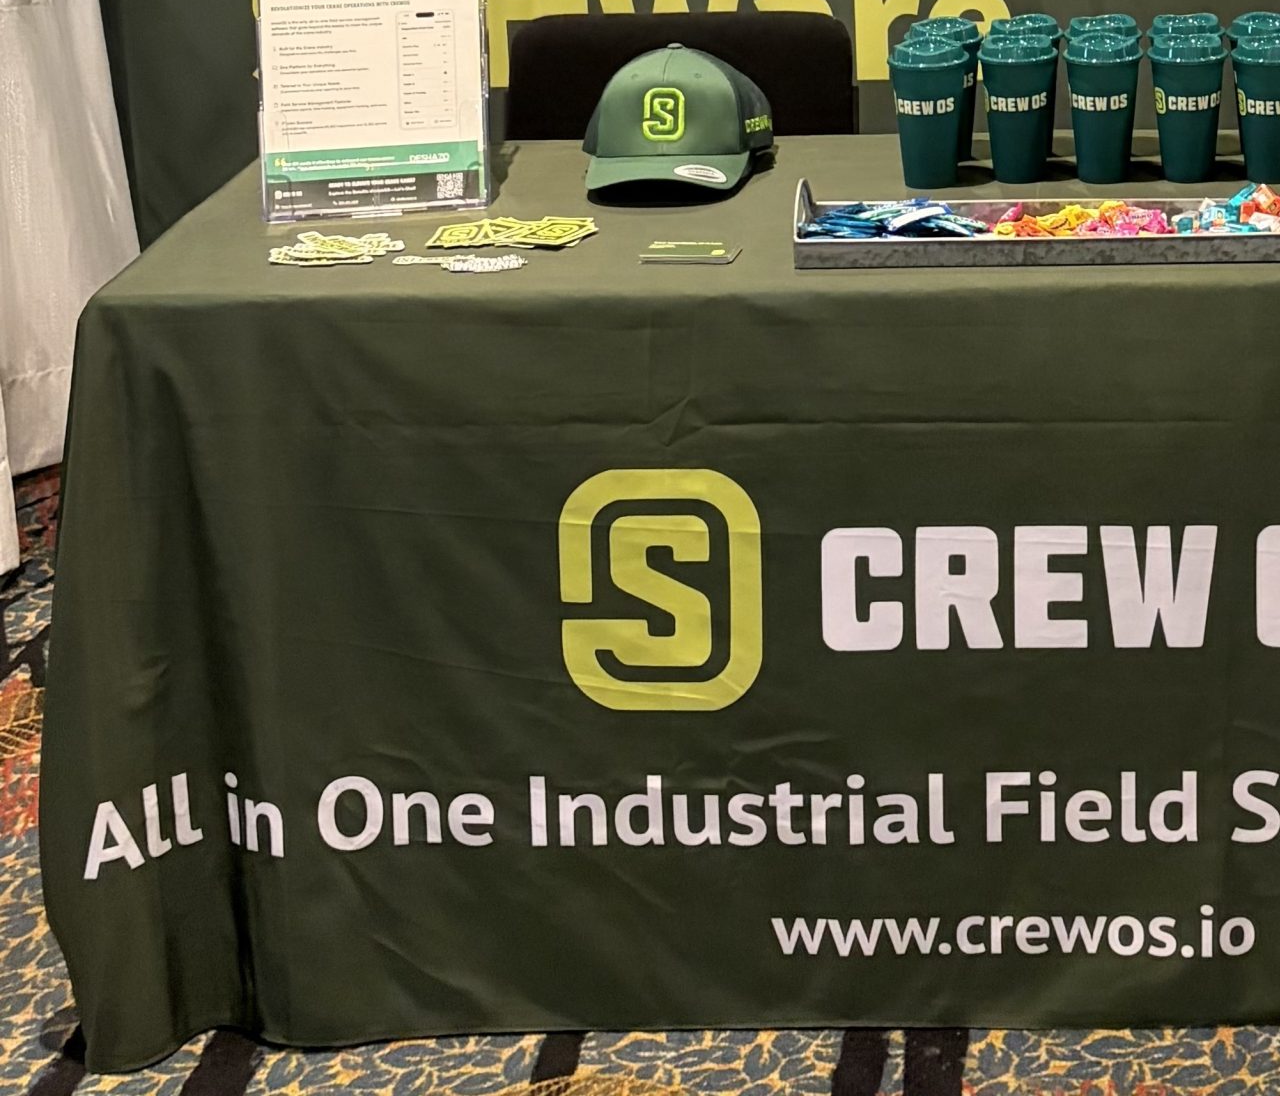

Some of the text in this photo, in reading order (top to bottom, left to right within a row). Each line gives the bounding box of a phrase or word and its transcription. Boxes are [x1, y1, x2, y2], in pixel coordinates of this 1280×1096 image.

[897, 97, 955, 116] CREW OS
[991, 91, 1047, 112] CREW OS
[1072, 93, 1128, 111] CREW OS
[1168, 94, 1209, 112] CREW
[821, 525, 1218, 651] CREW
[83, 772, 203, 879] All
[224, 772, 285, 858] in
[317, 775, 495, 851] One
[529, 773, 955, 847] Industrial
[985, 770, 1198, 843] Field
[770, 904, 1256, 958] www.crewos.io
